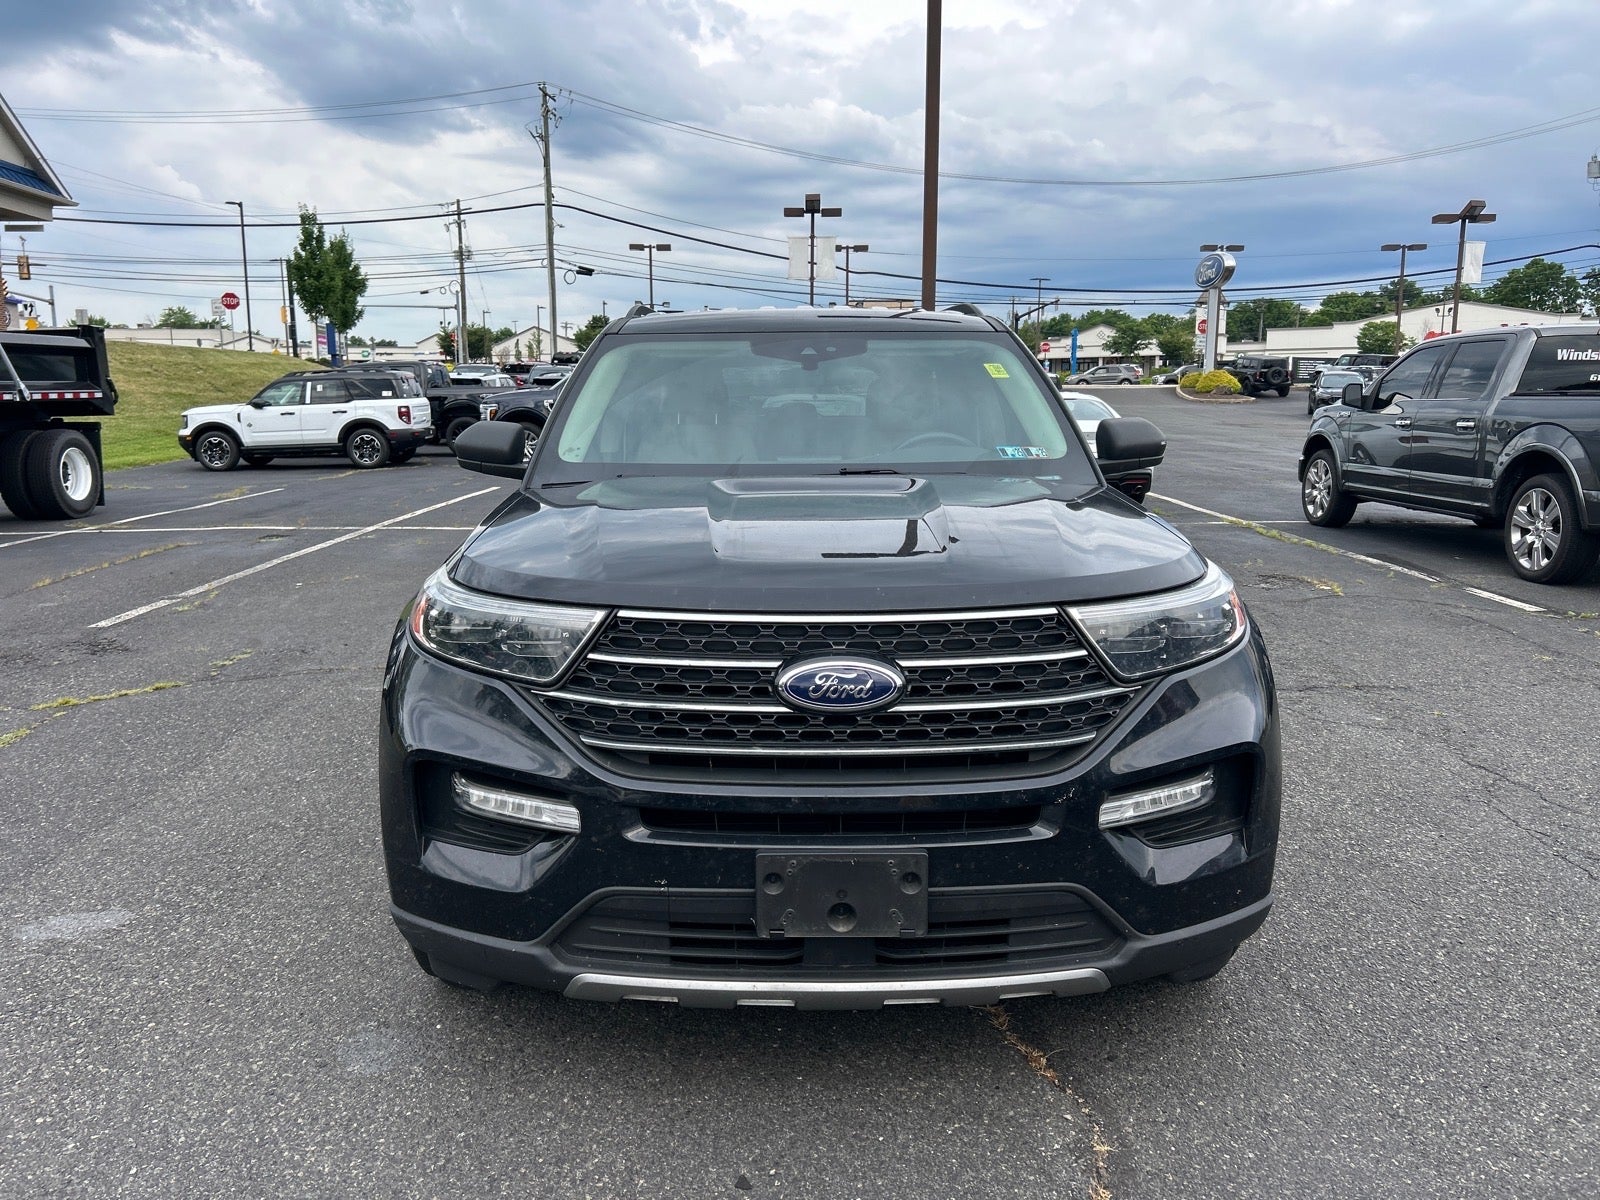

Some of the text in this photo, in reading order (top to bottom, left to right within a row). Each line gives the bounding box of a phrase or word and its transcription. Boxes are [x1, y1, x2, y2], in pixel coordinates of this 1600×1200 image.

[1198, 260, 1218, 283] Ford
[222, 297, 239, 305] STOP
[1557, 348, 1600, 361] Winds
[808, 672, 874, 700] Ford
